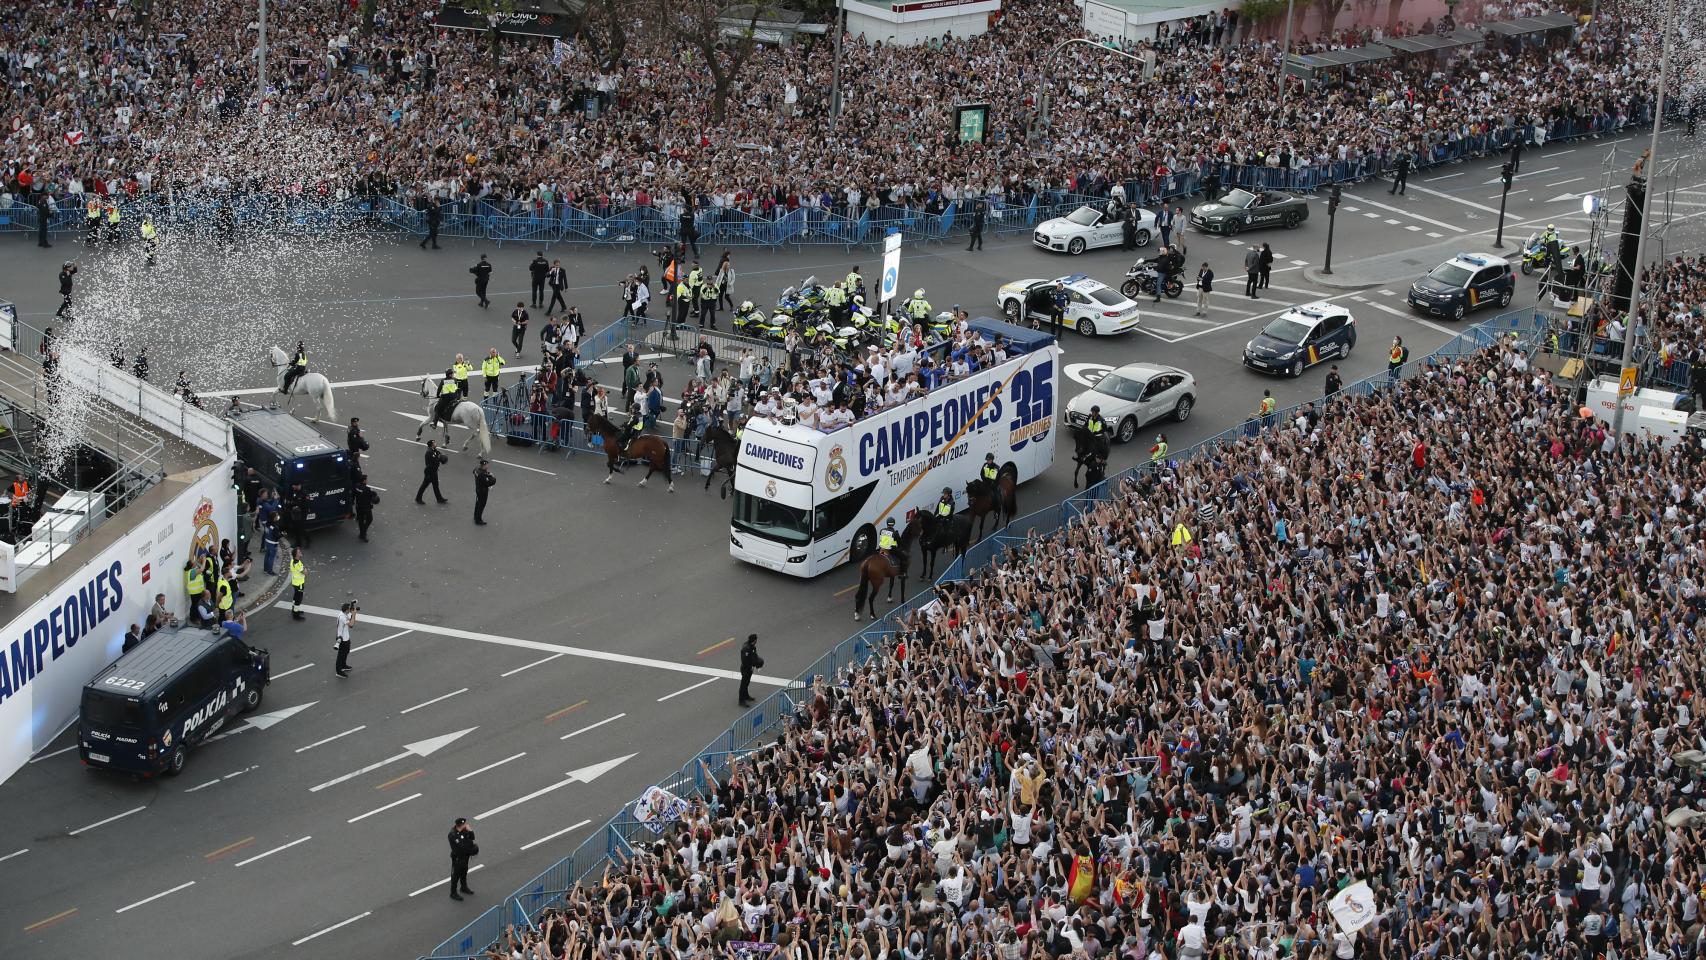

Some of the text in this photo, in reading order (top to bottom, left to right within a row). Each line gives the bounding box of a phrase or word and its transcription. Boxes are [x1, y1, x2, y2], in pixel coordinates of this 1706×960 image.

[463, 8, 538, 20] CAAMOMO
[1010, 360, 1053, 452] 35
[1601, 400, 1635, 412] aggko
[859, 381, 1003, 477] CAMPEONES
[1009, 416, 1052, 446] CAMPEONES
[295, 443, 329, 453] 6221
[745, 442, 805, 471] CAMPEONES
[890, 442, 969, 487] TEMPORADA 2021/2022
[0, 560, 123, 705] AMPEONES
[105, 677, 146, 690] 6222
[182, 690, 227, 739] POLICÍA
